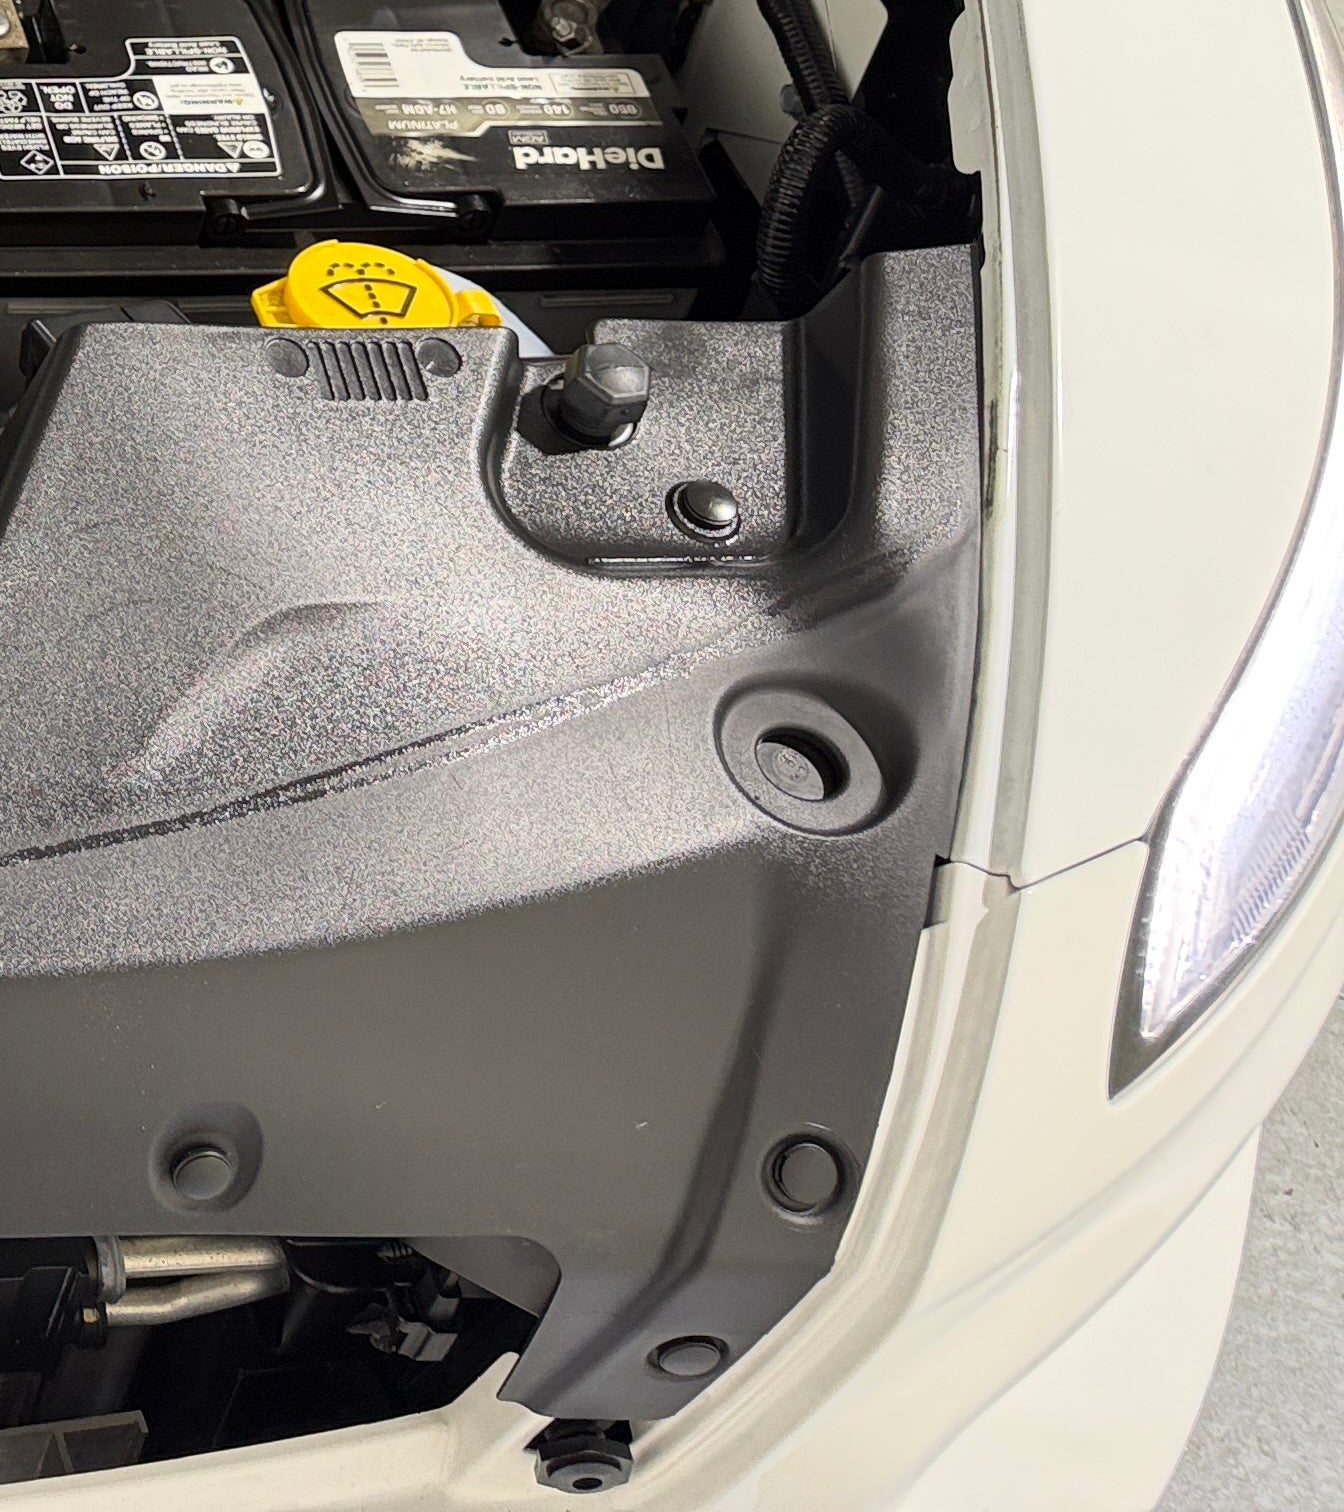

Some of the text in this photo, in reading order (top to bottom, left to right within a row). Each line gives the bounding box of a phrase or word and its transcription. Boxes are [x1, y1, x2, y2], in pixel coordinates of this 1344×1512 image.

[388, 120, 458, 130] PLATINUM
[512, 146, 665, 170] DieHard
[99, 163, 226, 174] DANGER/POISON
